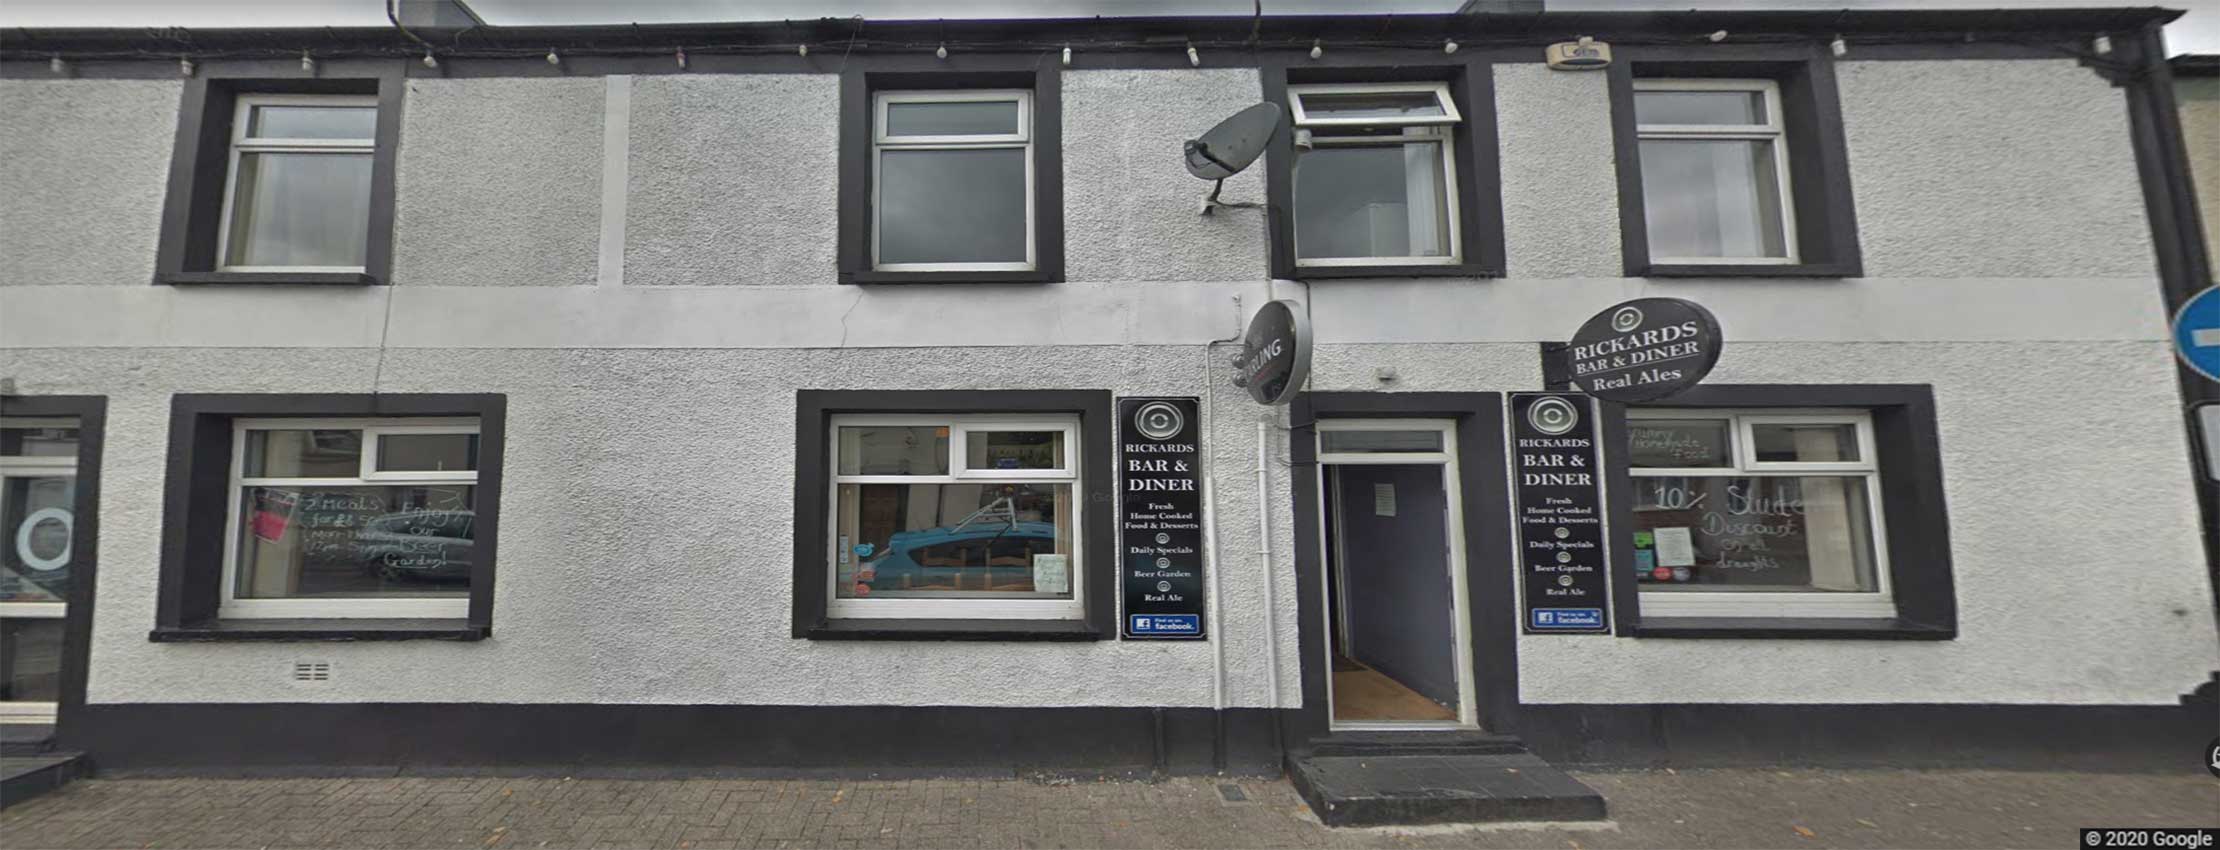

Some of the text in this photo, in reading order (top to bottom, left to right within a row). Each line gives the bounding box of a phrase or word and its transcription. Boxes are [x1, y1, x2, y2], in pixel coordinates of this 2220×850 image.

[1574, 321, 1698, 361] RICKARDS
[1247, 338, 1281, 377] RLING
[1576, 341, 1700, 375] BAR & DINER
[1593, 368, 1682, 392] Real Ales
[1125, 443, 1195, 453] RICKARDS
[1519, 438, 1590, 448] RICKARDS
[1128, 459, 1189, 472] BAR &
[1523, 454, 1585, 467] BAR &
[1128, 478, 1195, 491] DINER
[1524, 473, 1592, 486] DINER
[1148, 502, 1175, 510] Fresh
[1545, 497, 1573, 505] Fresh
[1130, 512, 1193, 520] Home Cooked
[1130, 546, 1193, 555] Daily Specials
[1529, 541, 1594, 549] Daily Specials
[1546, 588, 1586, 596] Real Ale
